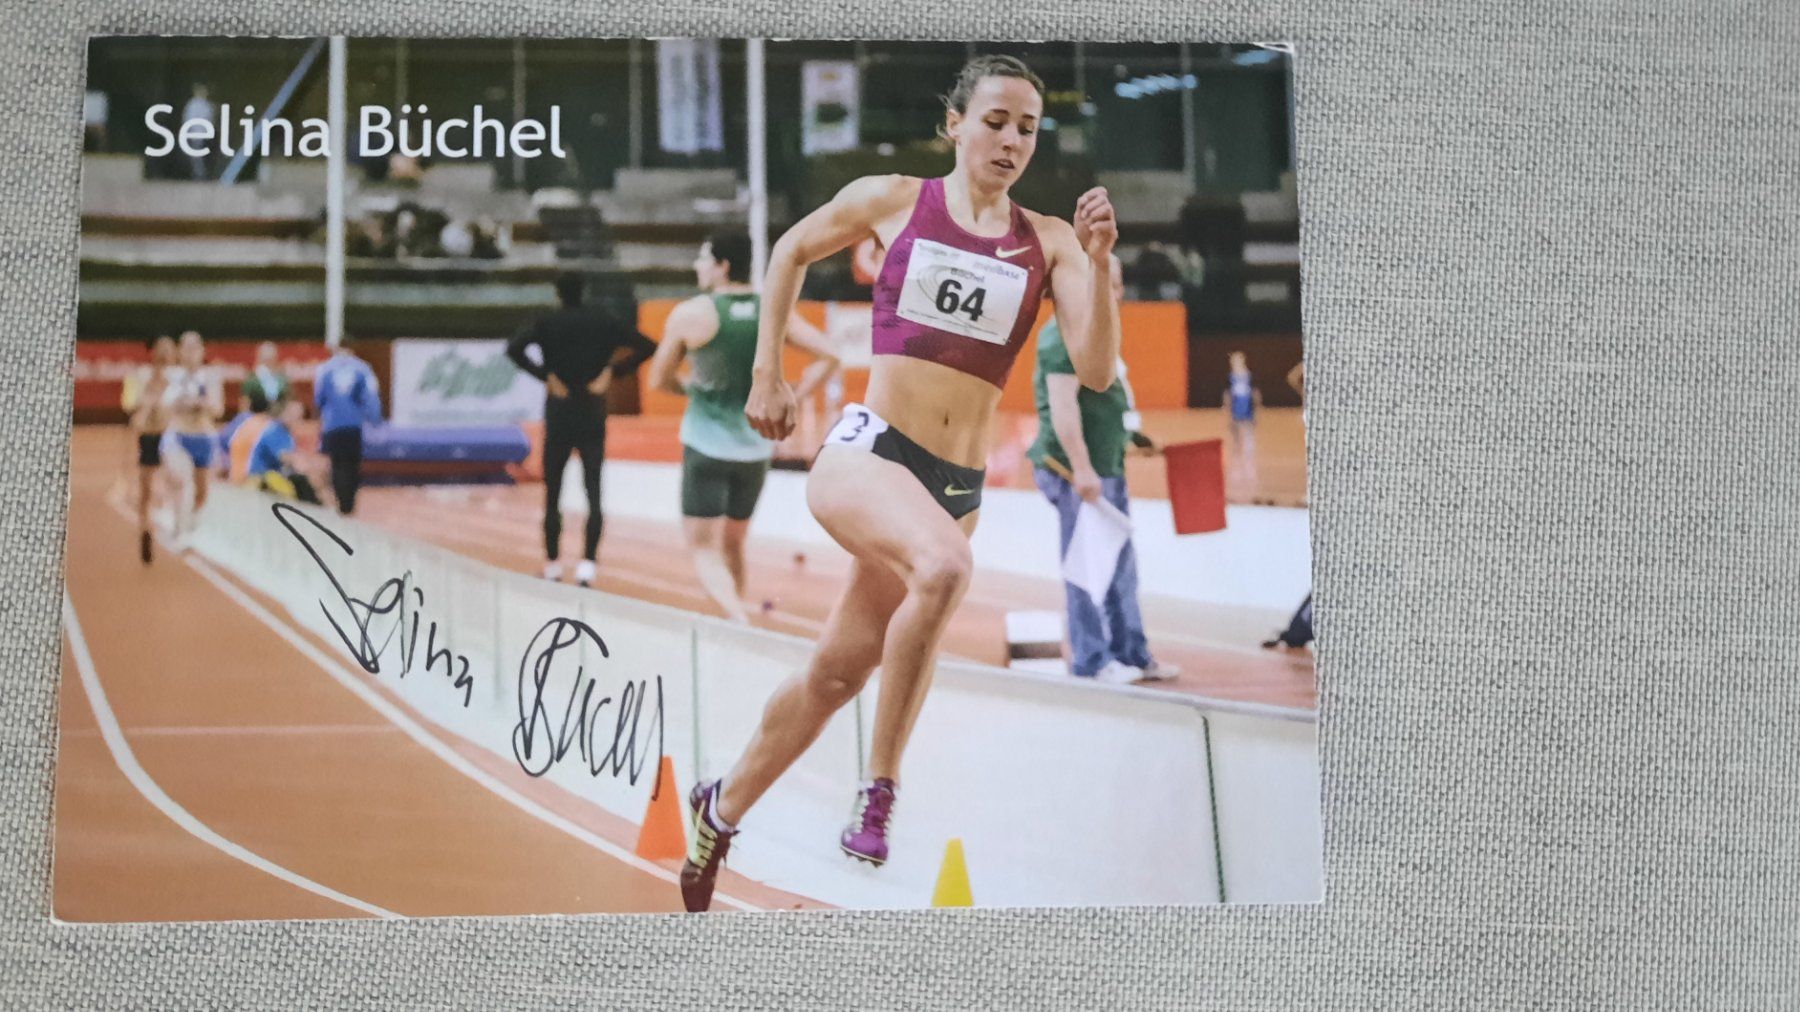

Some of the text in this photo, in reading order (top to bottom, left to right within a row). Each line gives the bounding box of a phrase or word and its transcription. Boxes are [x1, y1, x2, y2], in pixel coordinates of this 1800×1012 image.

[144, 104, 566, 158] Selina Büchel
[936, 279, 986, 322] 64
[840, 411, 869, 441] 3
